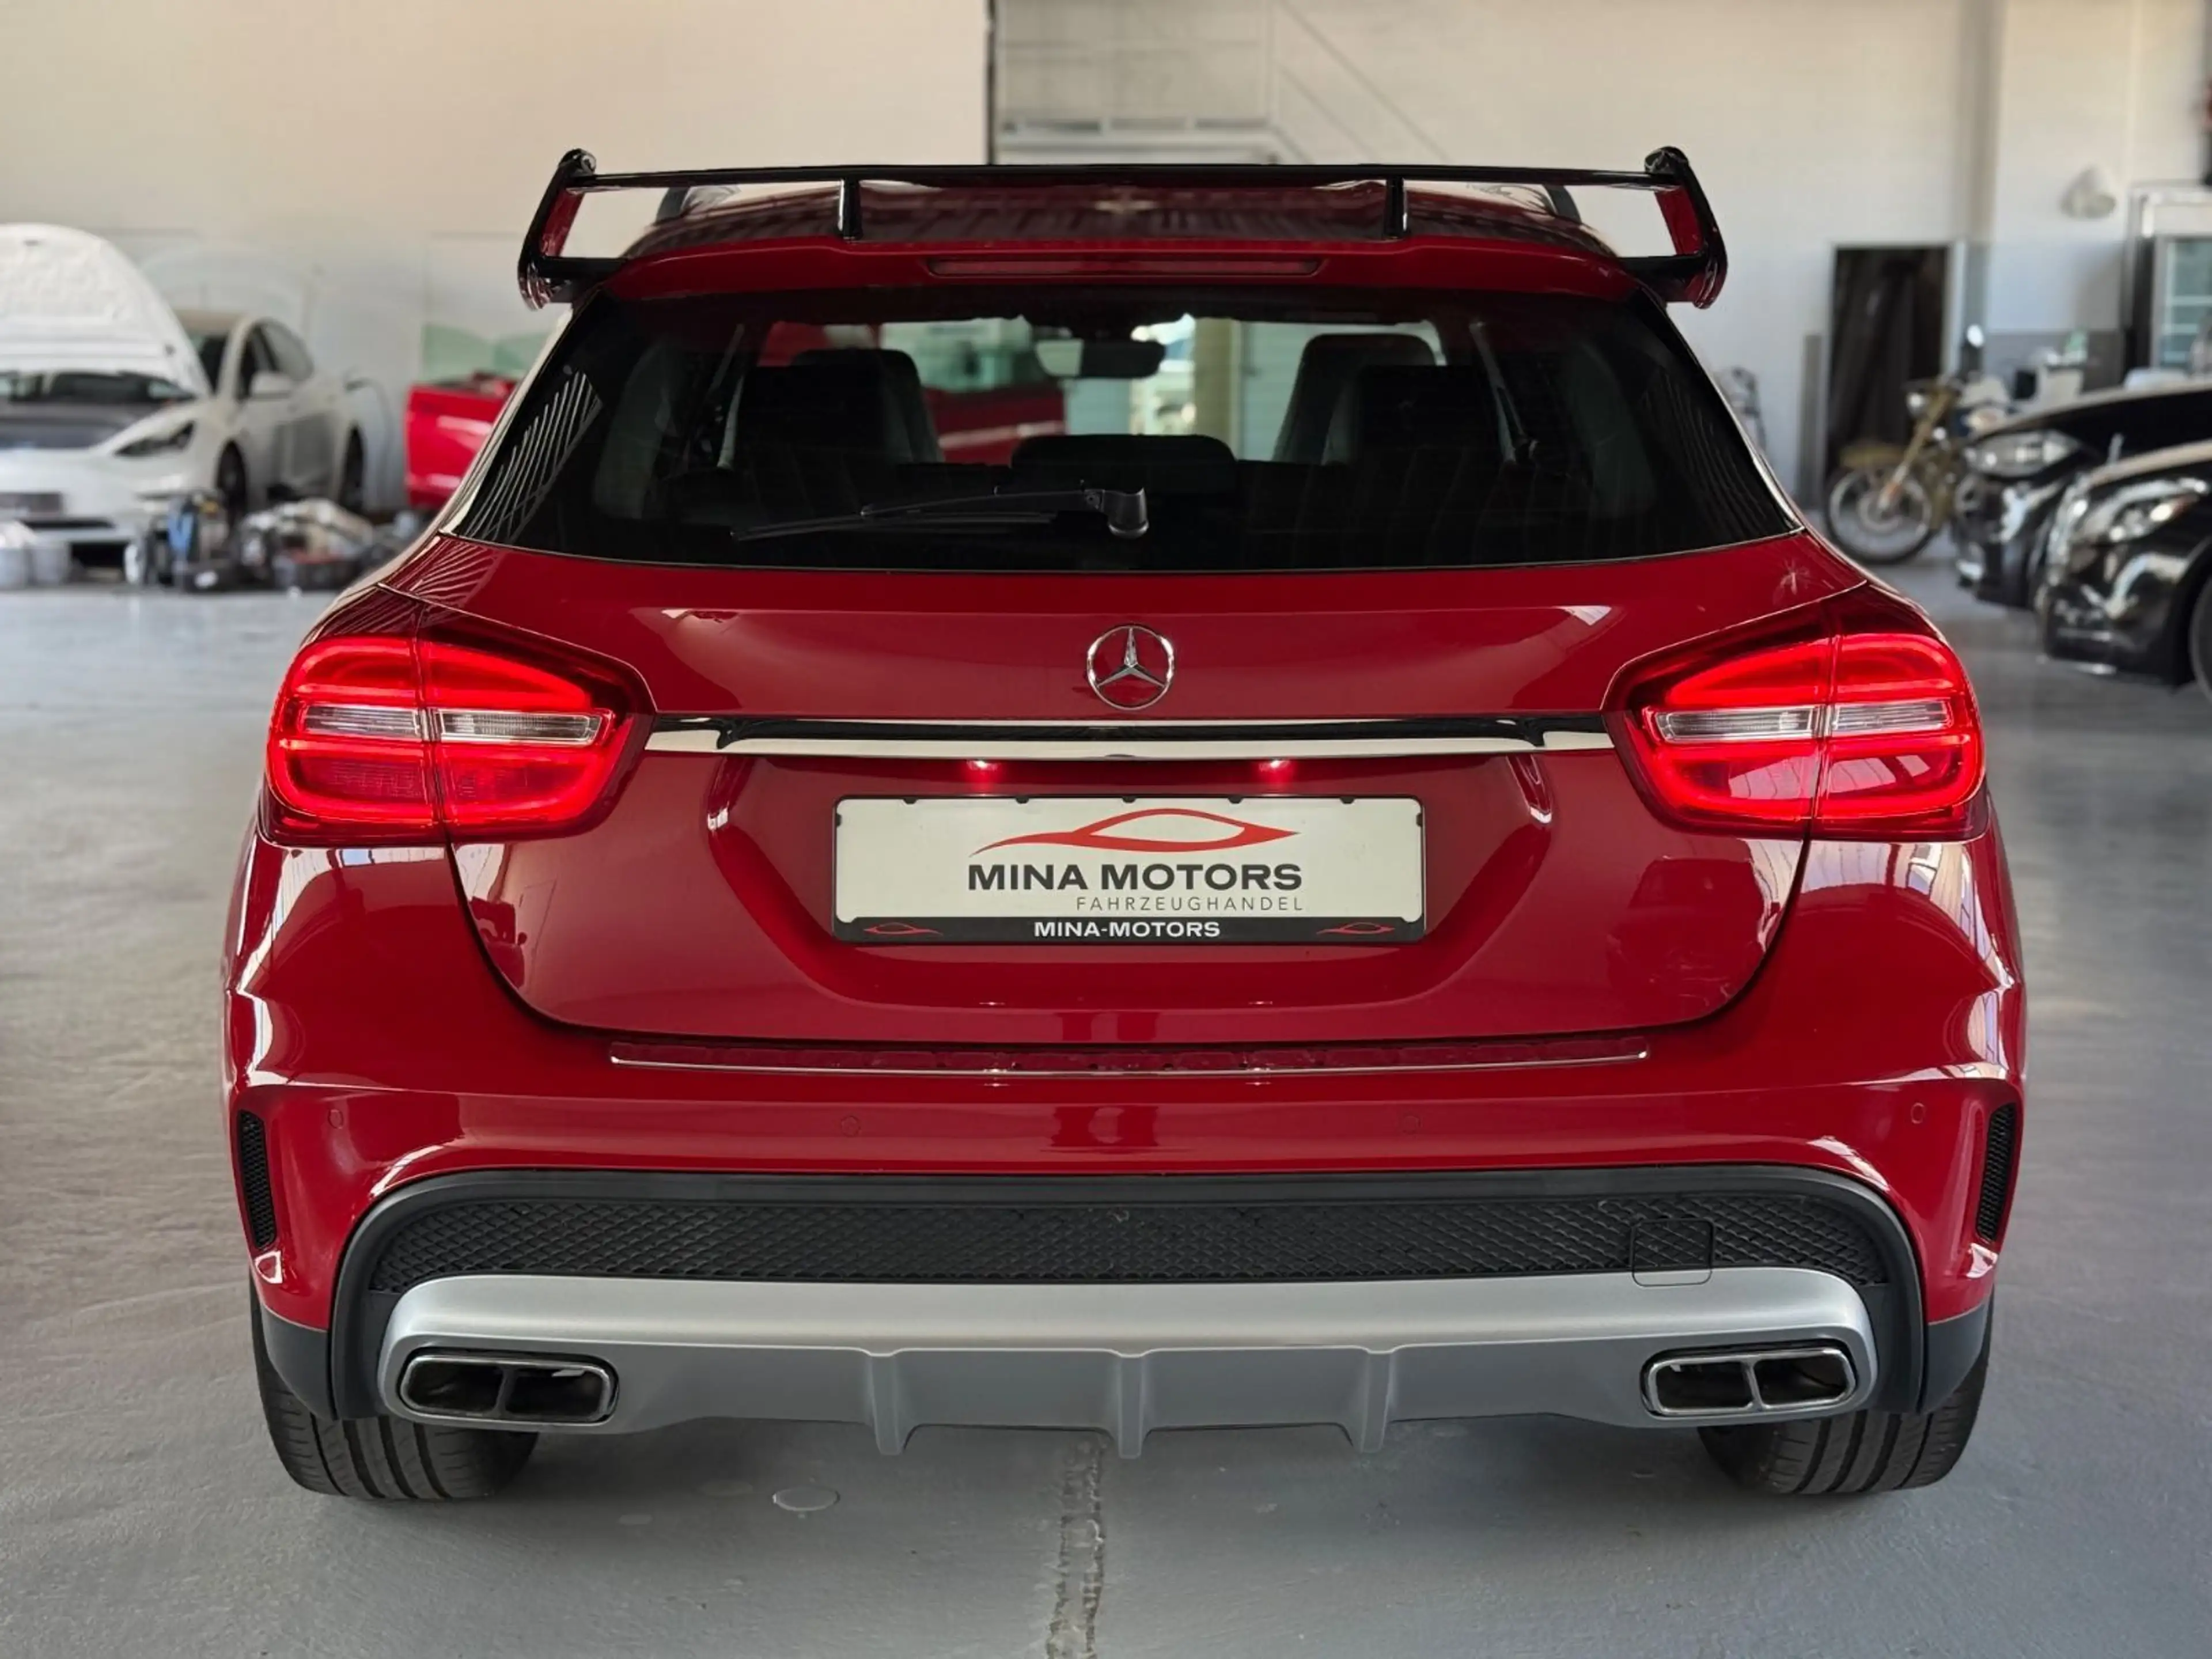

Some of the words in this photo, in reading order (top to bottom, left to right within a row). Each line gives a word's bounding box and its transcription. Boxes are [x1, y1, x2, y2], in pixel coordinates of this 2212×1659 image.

[969, 864, 1088, 891] MINA
[1101, 863, 1302, 891] MOTORS
[1077, 896, 1303, 911] FAHRZEUGHANDEL
[1035, 922, 1220, 937] MINA-MOTORS
